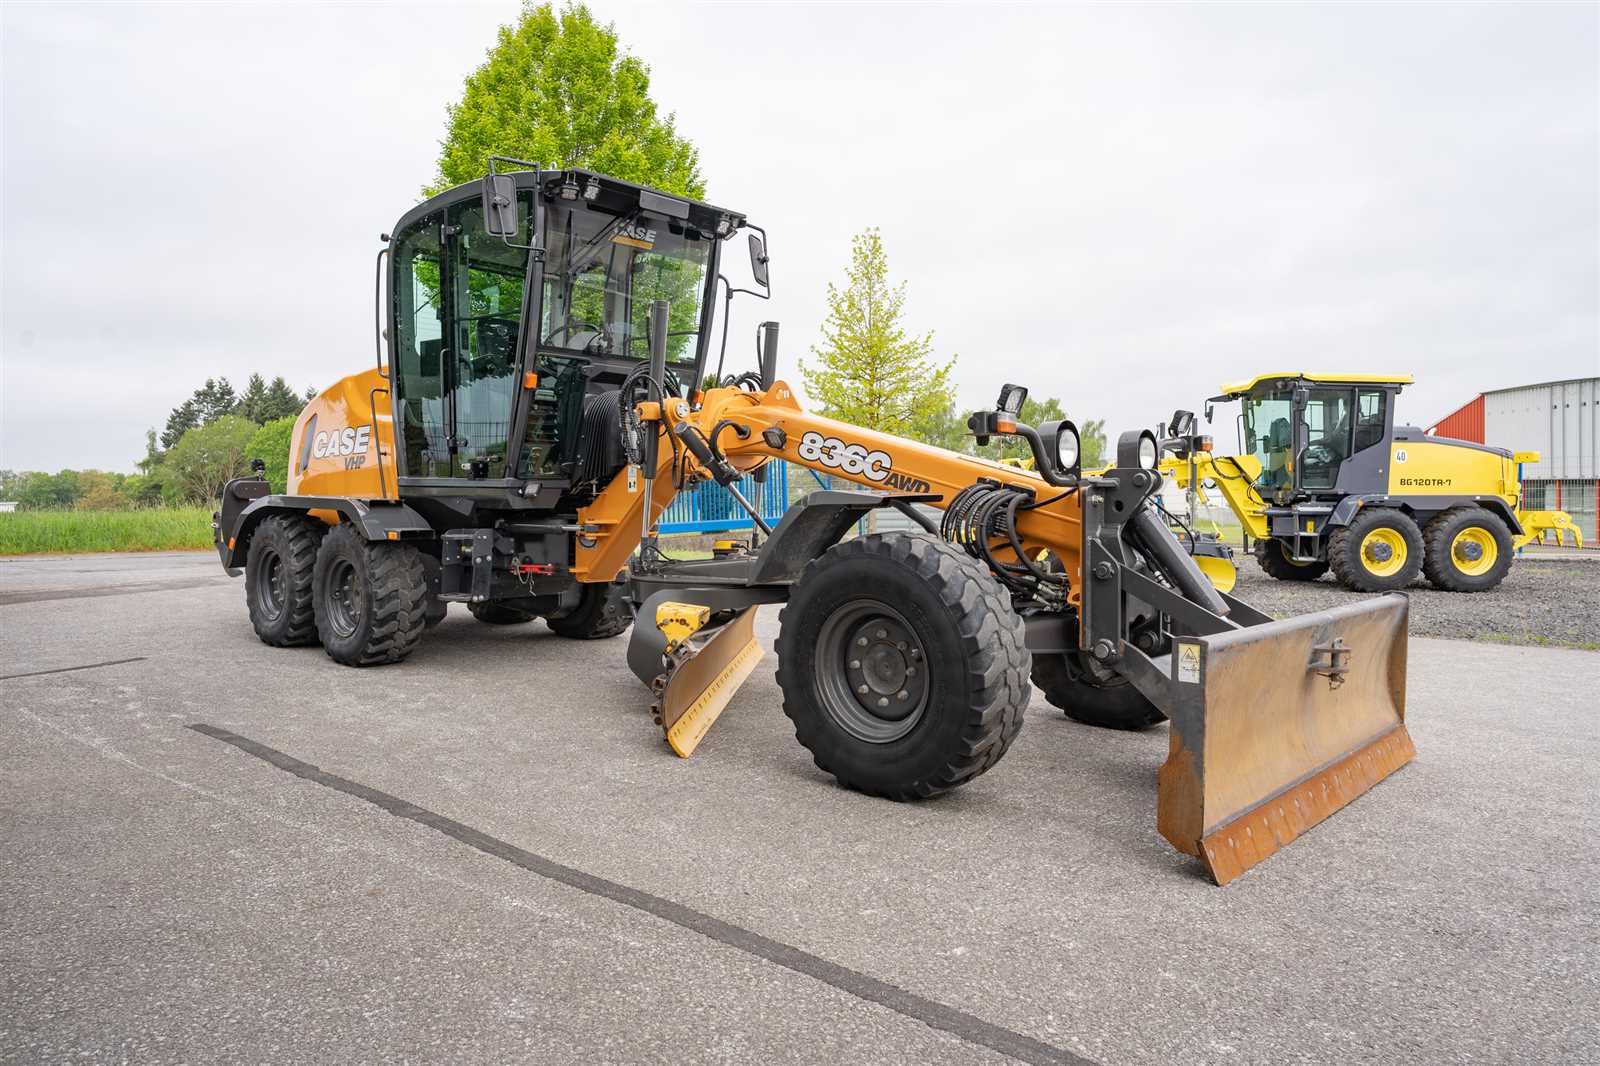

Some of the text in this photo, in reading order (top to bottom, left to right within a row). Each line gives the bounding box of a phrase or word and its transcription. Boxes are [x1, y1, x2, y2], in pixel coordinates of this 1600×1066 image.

[313, 425, 371, 458] CASE
[345, 455, 366, 470] VHP
[798, 431, 930, 493] 836C AWD
[1396, 451, 1406, 461] 40
